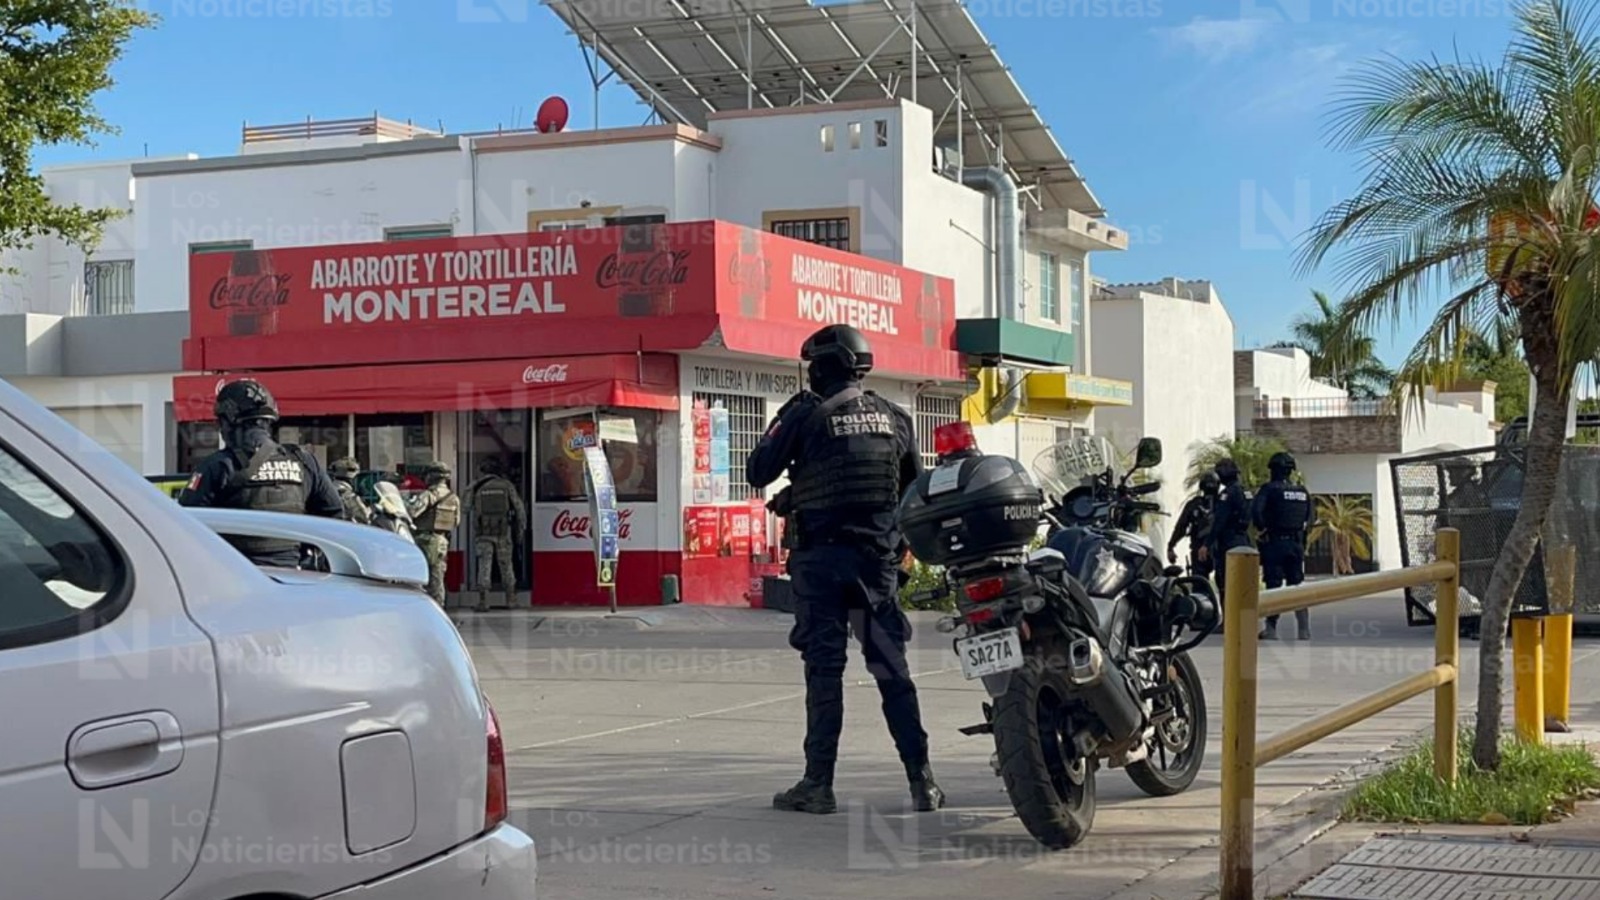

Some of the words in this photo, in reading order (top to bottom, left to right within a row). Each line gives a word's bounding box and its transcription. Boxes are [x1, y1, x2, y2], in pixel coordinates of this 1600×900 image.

[310, 253, 419, 289] ABARROTE
[422, 252, 439, 283] Y
[441, 236, 578, 282] TORTILLERÍA
[791, 253, 842, 291] ABARROTE
[841, 265, 850, 292] Y
[850, 268, 904, 305] TORTILLERÍA
[323, 281, 566, 324] MONTEREAL
[797, 289, 899, 335] MONTEREAL
[694, 366, 743, 390] TORTILLERIA
[745, 371, 753, 392] Y
[831, 411, 891, 425] POLICÍA
[834, 423, 894, 437] ESTATAL
[258, 458, 302, 472] OLICÍA
[967, 640, 1013, 667] SA27A
